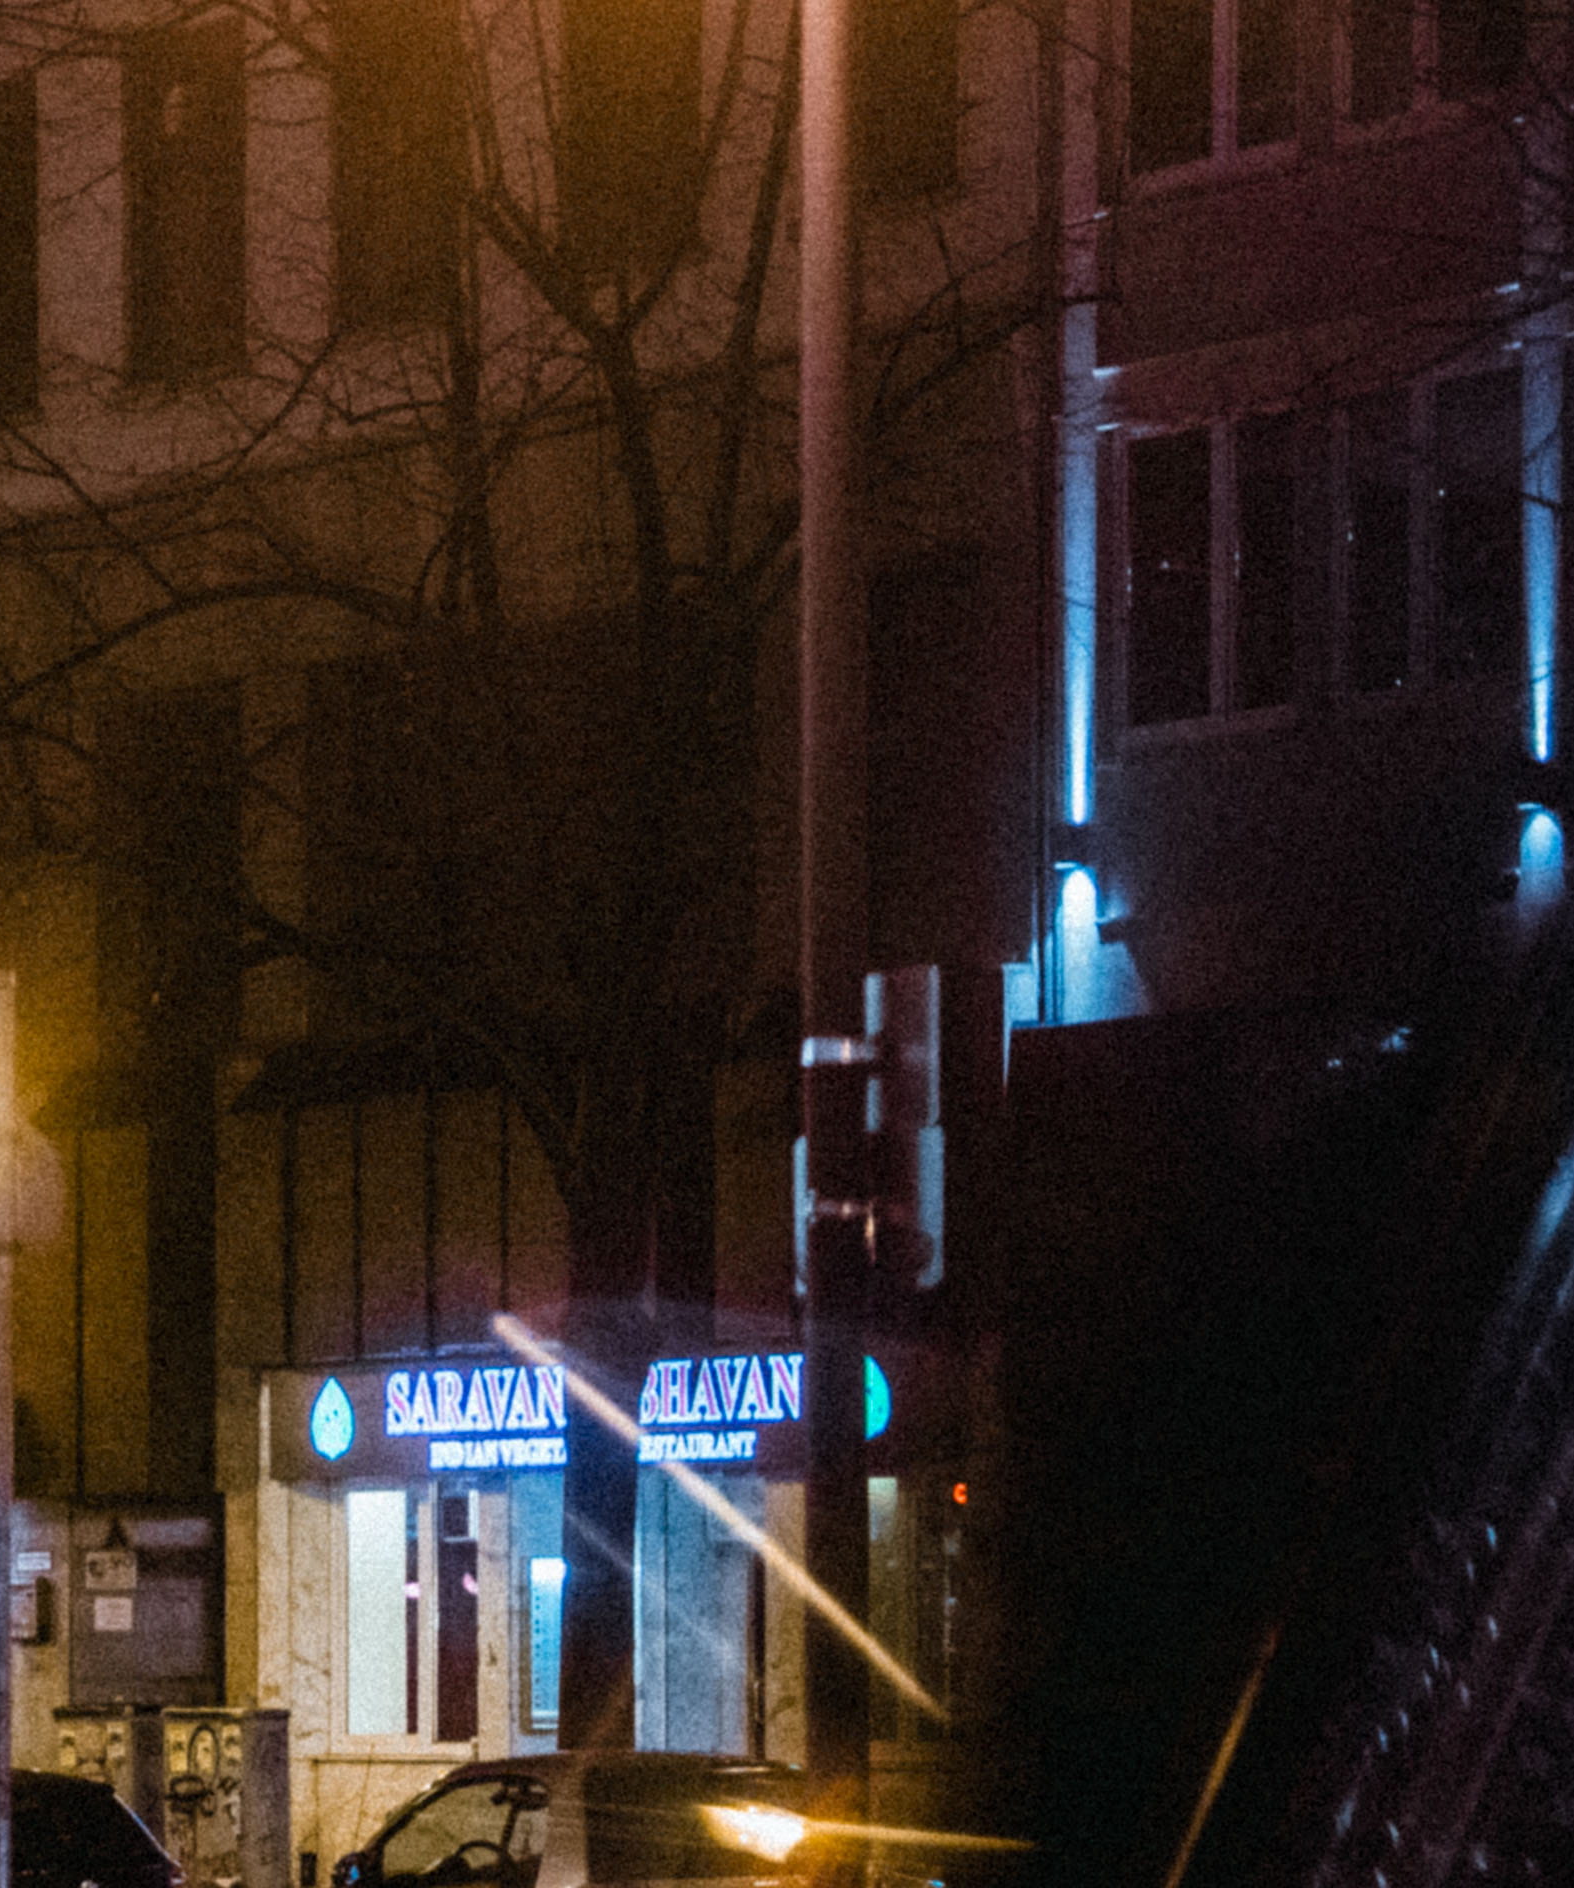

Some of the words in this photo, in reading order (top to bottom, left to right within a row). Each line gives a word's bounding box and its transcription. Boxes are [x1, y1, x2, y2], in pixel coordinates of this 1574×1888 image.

[387, 1365, 567, 1435] SARAVAN
[639, 1354, 804, 1426] BHAVAN
[429, 1440, 499, 1470] INDIAN
[499, 1436, 567, 1467] VEGET
[638, 1431, 757, 1462] ESTAURANT
